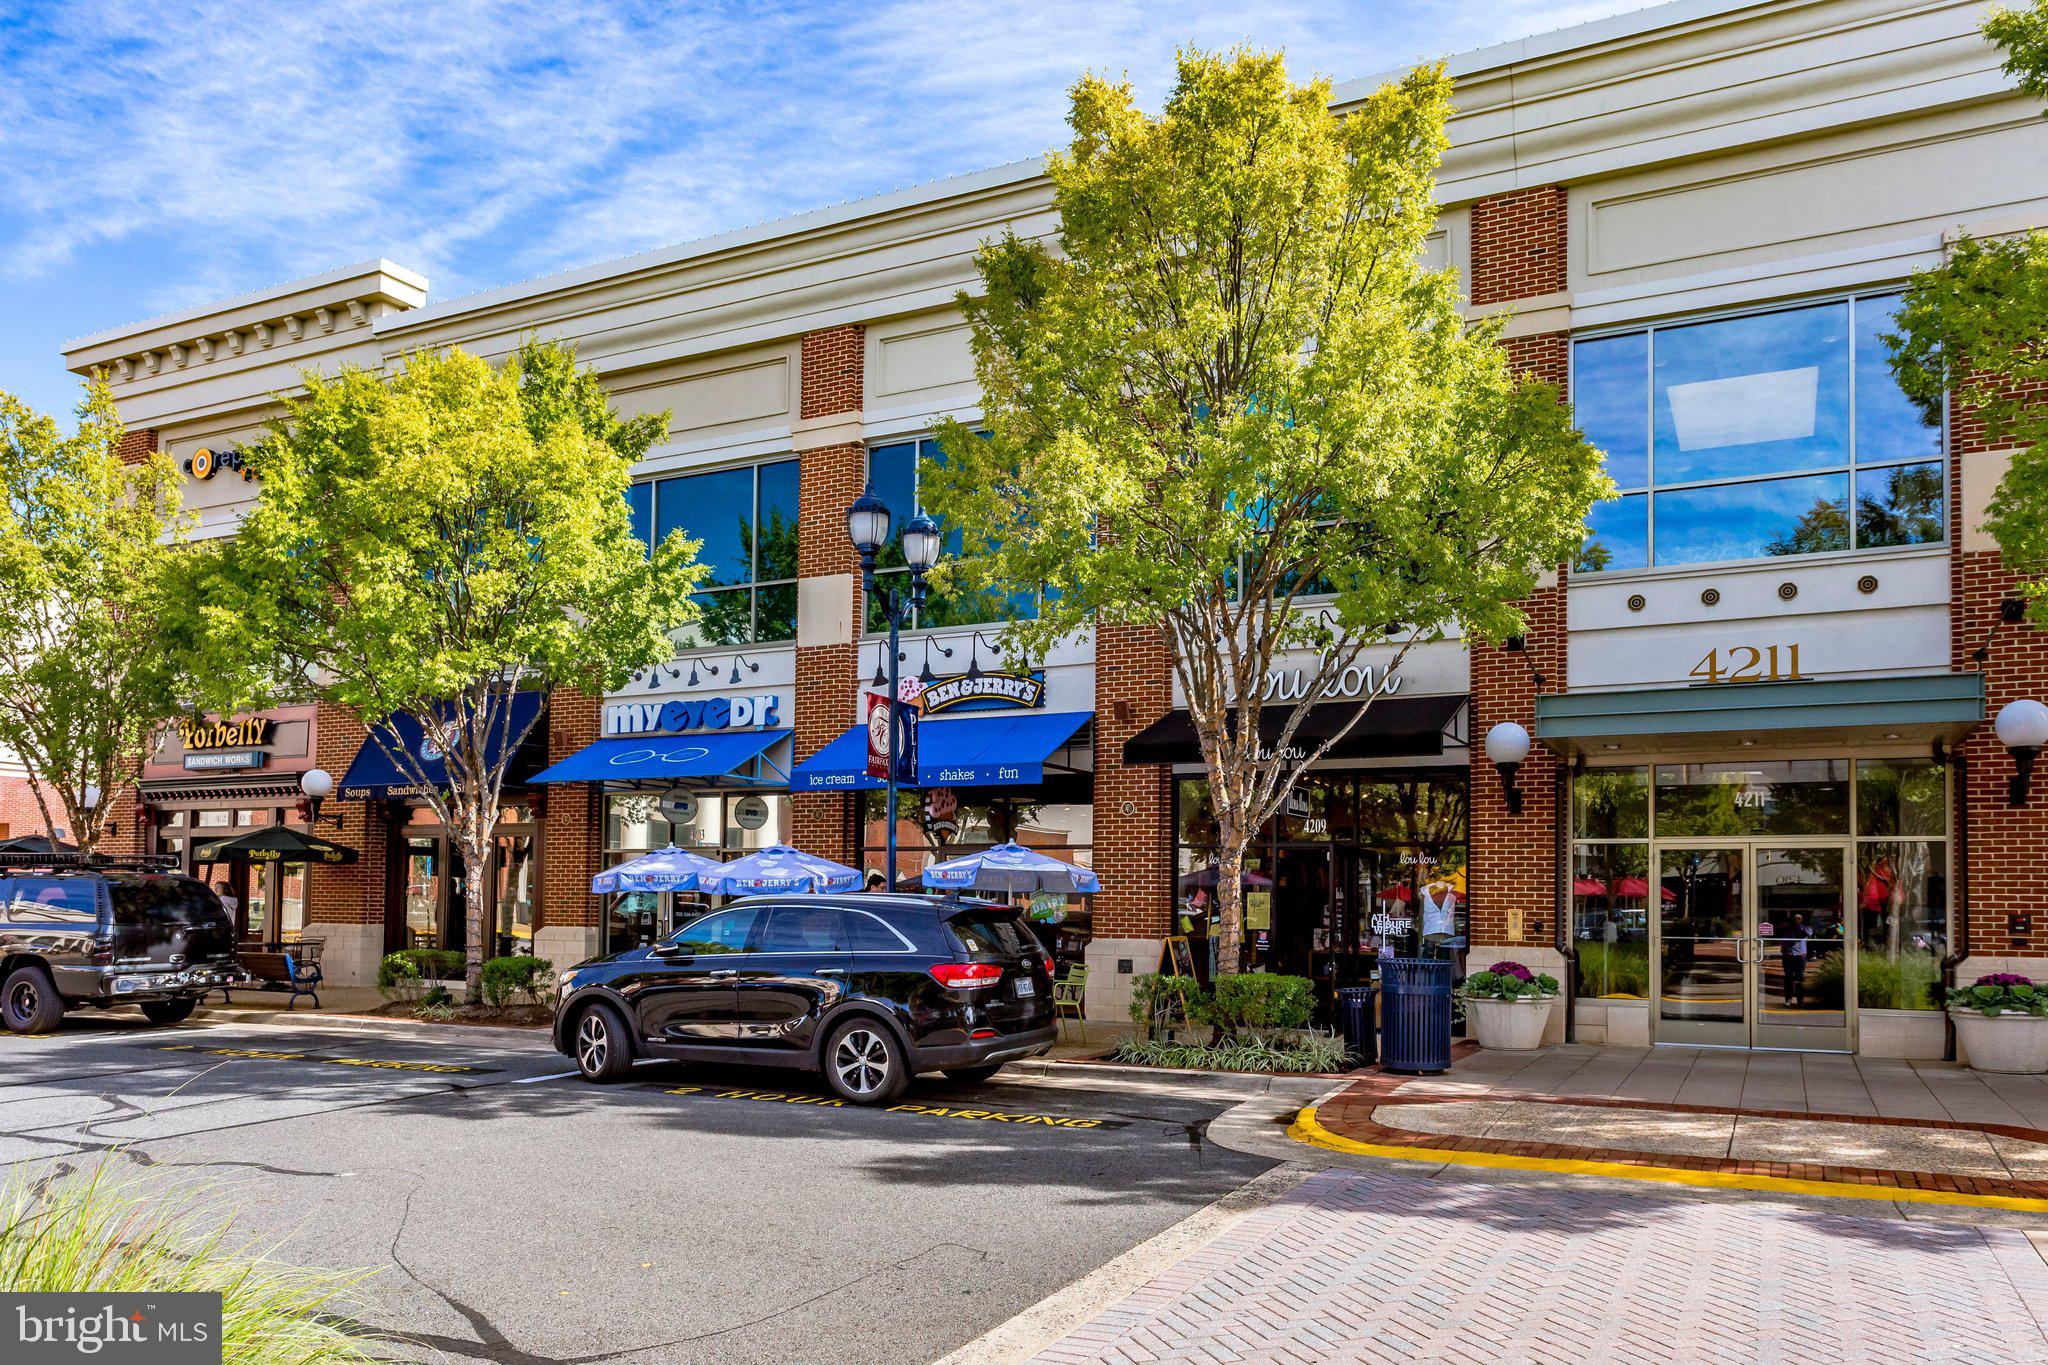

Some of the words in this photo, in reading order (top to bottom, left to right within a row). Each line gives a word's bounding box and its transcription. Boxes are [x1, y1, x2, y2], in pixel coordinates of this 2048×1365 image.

[1689, 643, 1803, 684] 4211
[909, 713, 918, 778] PLAY
[187, 755, 223, 767] SANDWICH
[224, 753, 251, 765] WORKS
[810, 774, 823, 786] ice
[825, 774, 856, 785] cream
[939, 768, 975, 781] shakes
[998, 767, 1019, 779] fun
[344, 787, 371, 799] Soups
[1735, 791, 1765, 807] 4211
[1303, 818, 1327, 834] 4209
[1399, 849, 1418, 865] lou
[1419, 851, 1438, 864] lou
[761, 878, 800, 888] JERRY'S
[1373, 926, 1403, 935] WEAR
[885, 1104, 1103, 1128] PARKING
